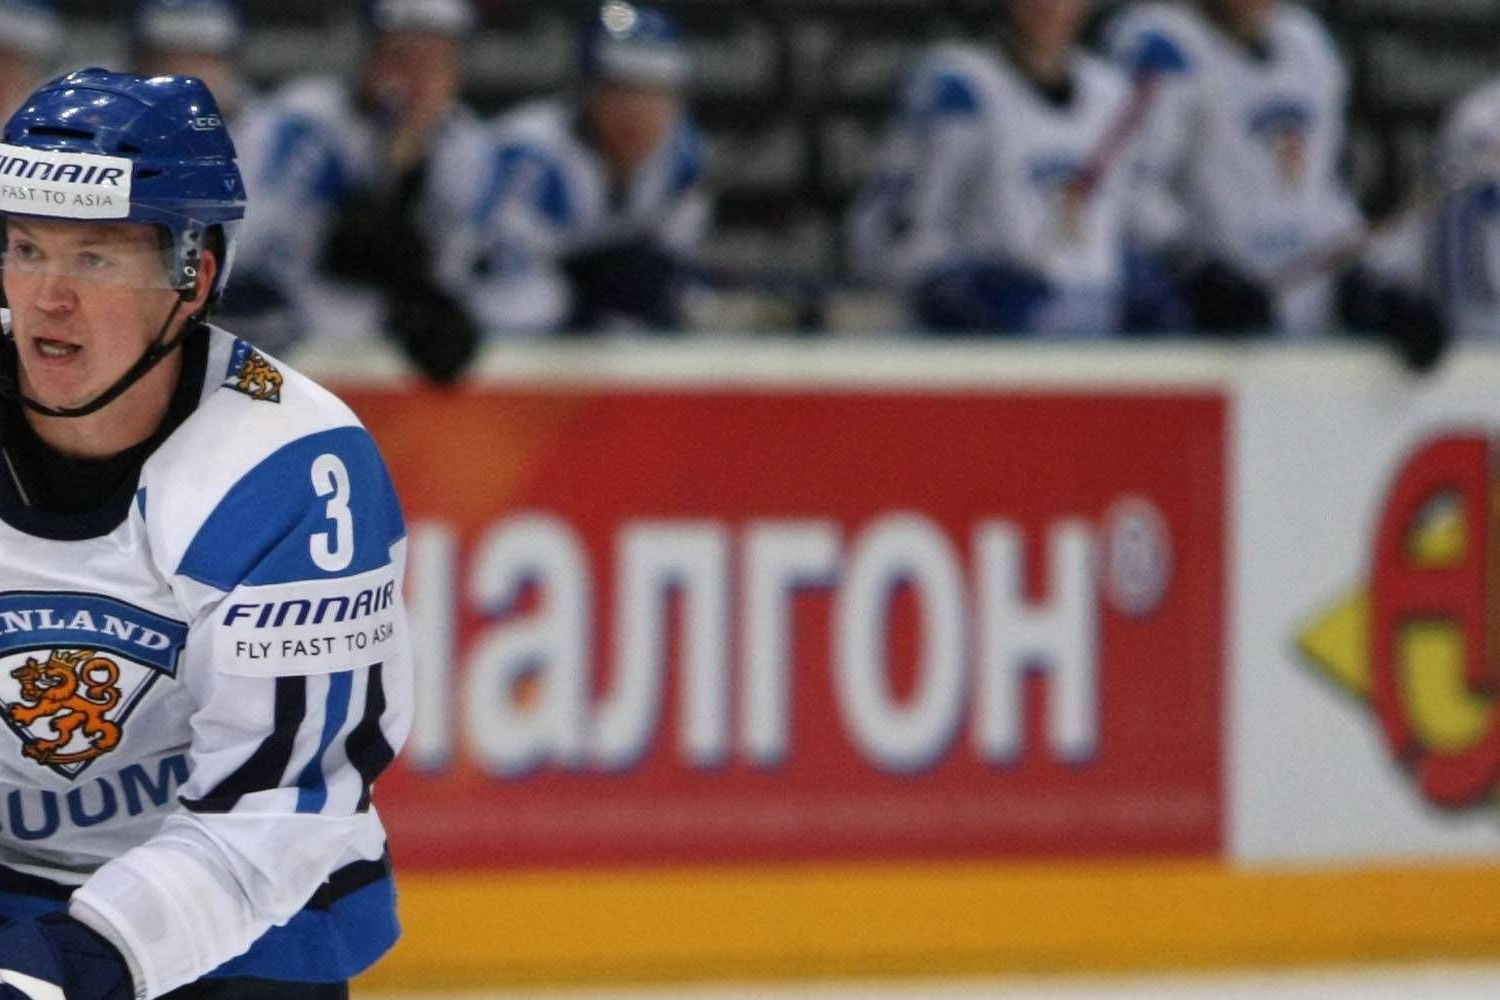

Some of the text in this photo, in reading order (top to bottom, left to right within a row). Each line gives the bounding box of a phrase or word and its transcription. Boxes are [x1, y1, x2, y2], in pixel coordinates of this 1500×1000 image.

[2, 185, 36, 201] FAST
[43, 189, 66, 204] TO
[72, 194, 113, 207] ASIA
[309, 453, 354, 572] 3
[222, 579, 395, 628] FINNAIR
[236, 641, 272, 659] FLY
[282, 637, 336, 657] FAST
[345, 631, 367, 651] TO
